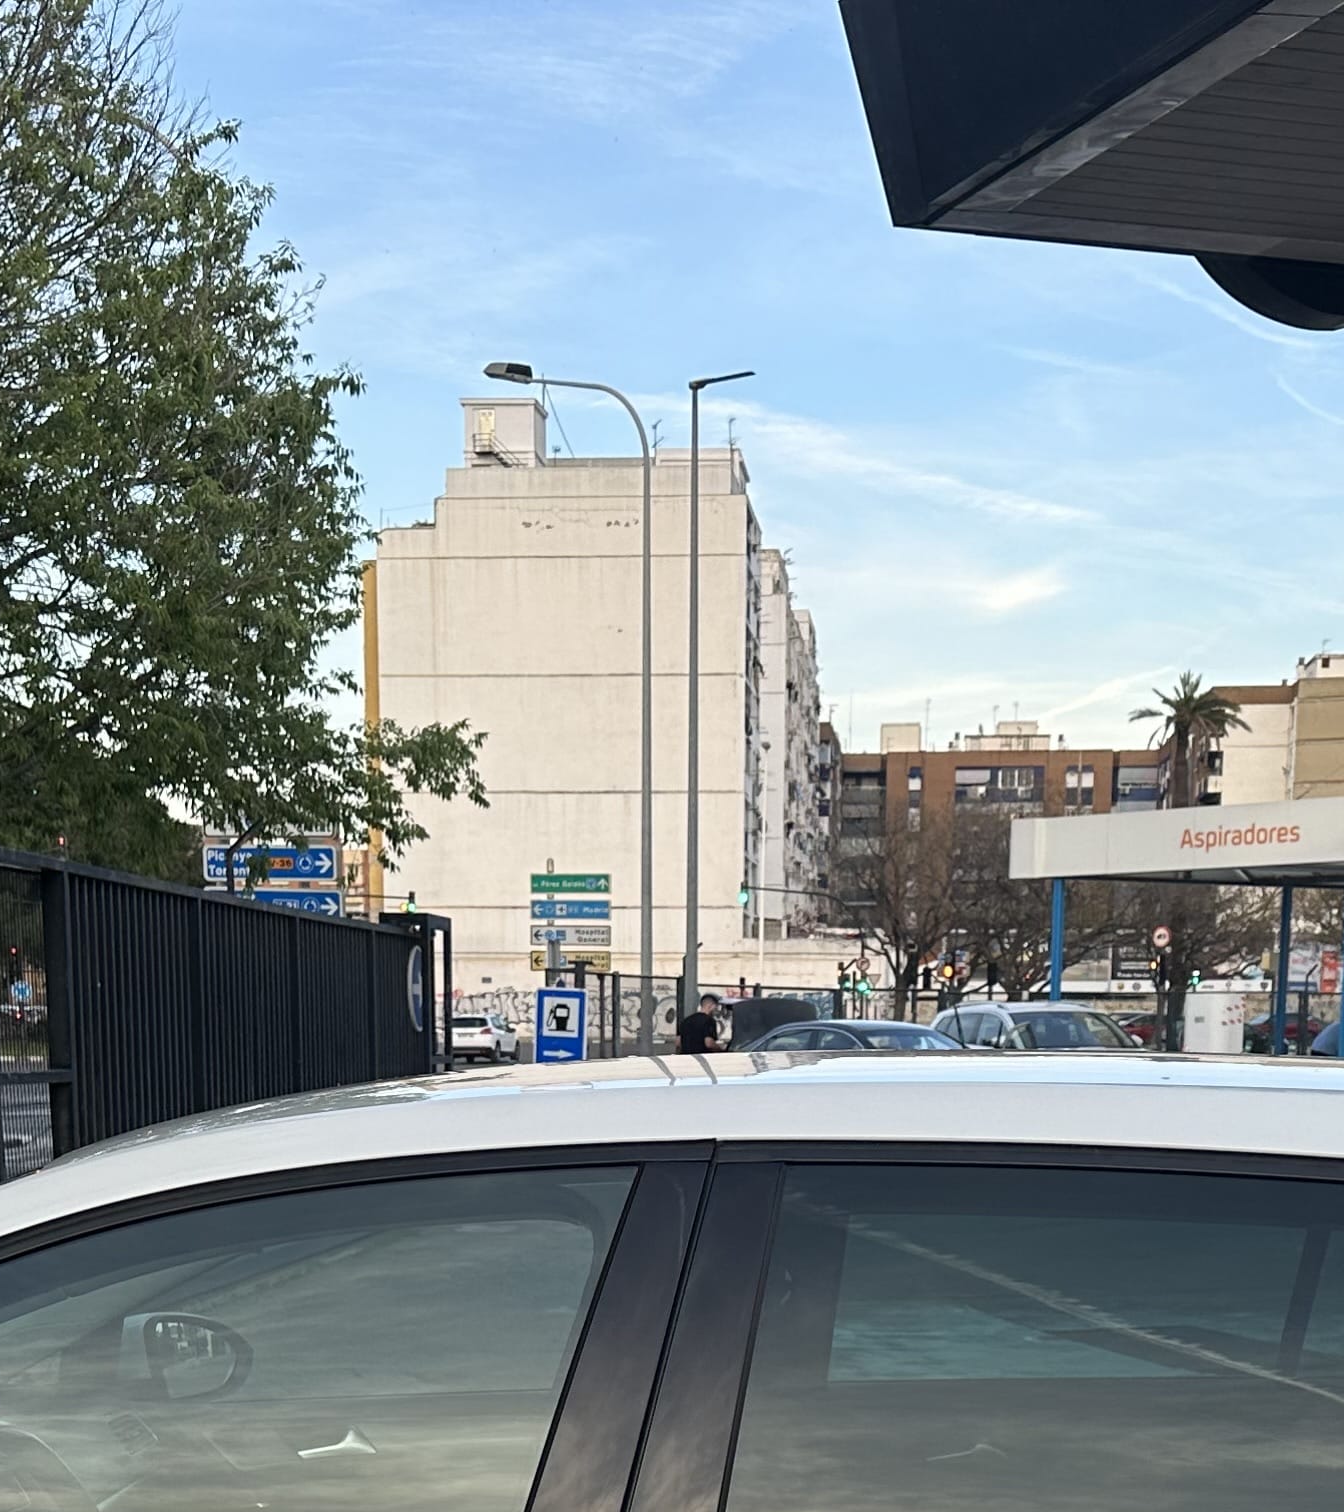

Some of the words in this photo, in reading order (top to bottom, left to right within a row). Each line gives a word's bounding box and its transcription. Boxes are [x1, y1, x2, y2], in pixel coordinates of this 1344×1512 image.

[1180, 824, 1300, 853] Aspiradores
[208, 850, 252, 862] Picny
[209, 864, 250, 876] Torent
